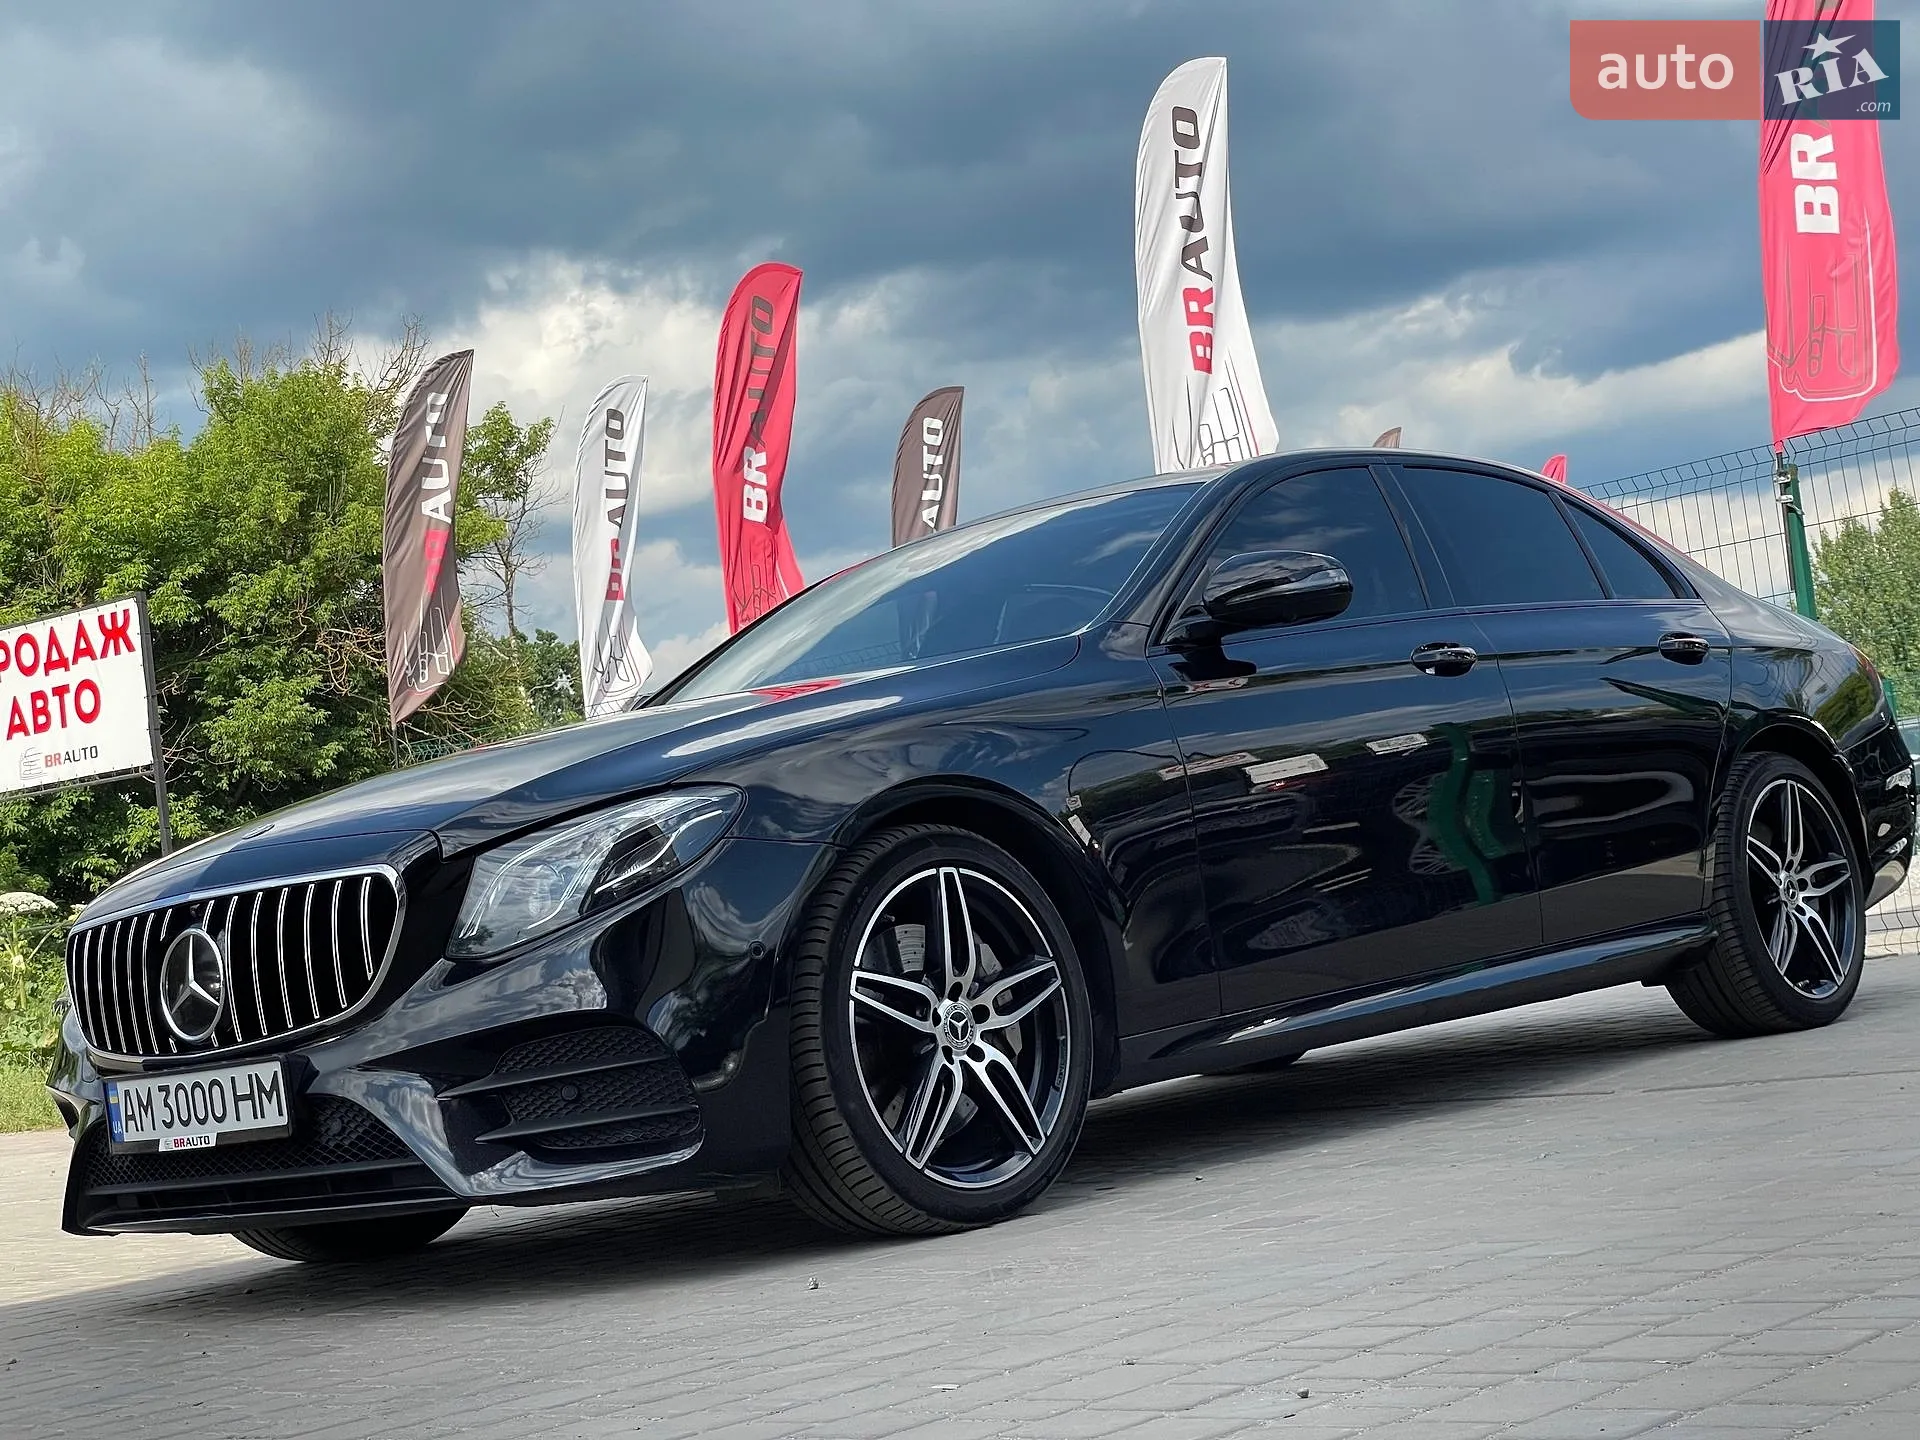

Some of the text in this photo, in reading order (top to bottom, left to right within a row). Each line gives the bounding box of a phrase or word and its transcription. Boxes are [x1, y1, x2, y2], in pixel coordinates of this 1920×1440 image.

[1171, 105, 1215, 375] BRAUTO
[6, 678, 101, 741] АВТО
[44, 745, 99, 768] BRAUTO
[124, 1070, 284, 1133] AM 3000 HM
[112, 1121, 123, 1134] UA
[173, 1135, 210, 1149] BRAUTO
